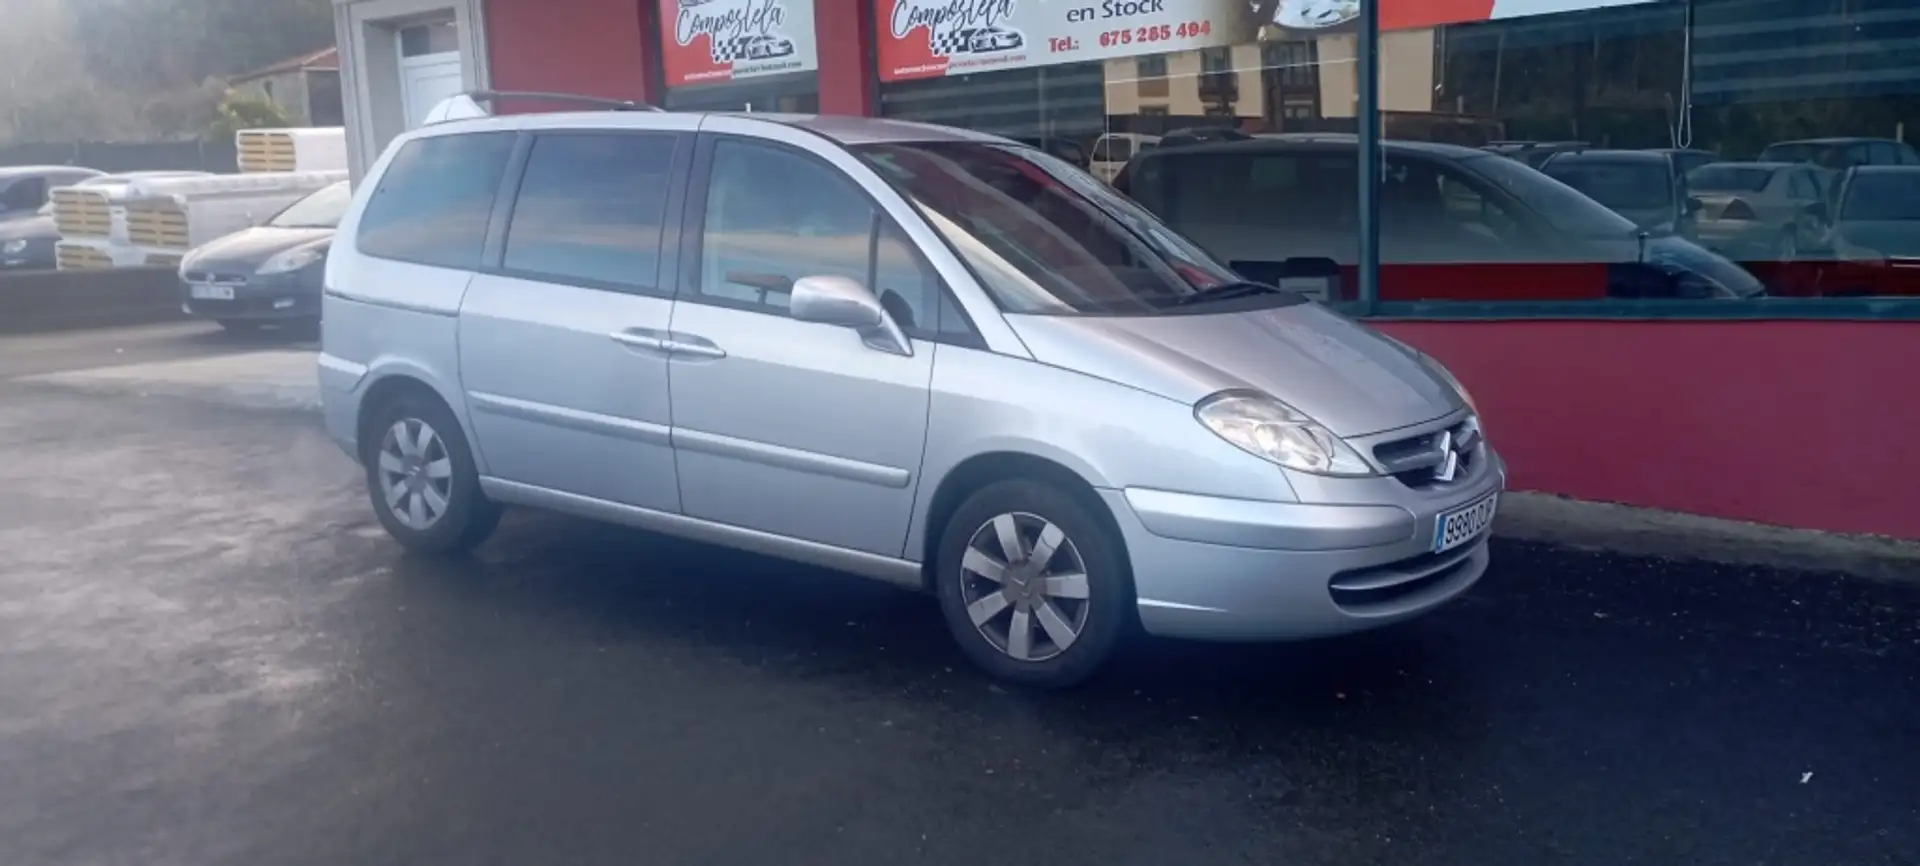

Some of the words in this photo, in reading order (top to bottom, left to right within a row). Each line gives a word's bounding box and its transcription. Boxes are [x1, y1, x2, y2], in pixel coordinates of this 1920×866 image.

[677, 0, 785, 50] Compostela
[893, 0, 1013, 41] Compostela
[1067, 7, 1094, 22] en
[1101, 0, 1164, 18] Stock
[1099, 29, 1132, 47] 675
[1136, 25, 1171, 43] 285
